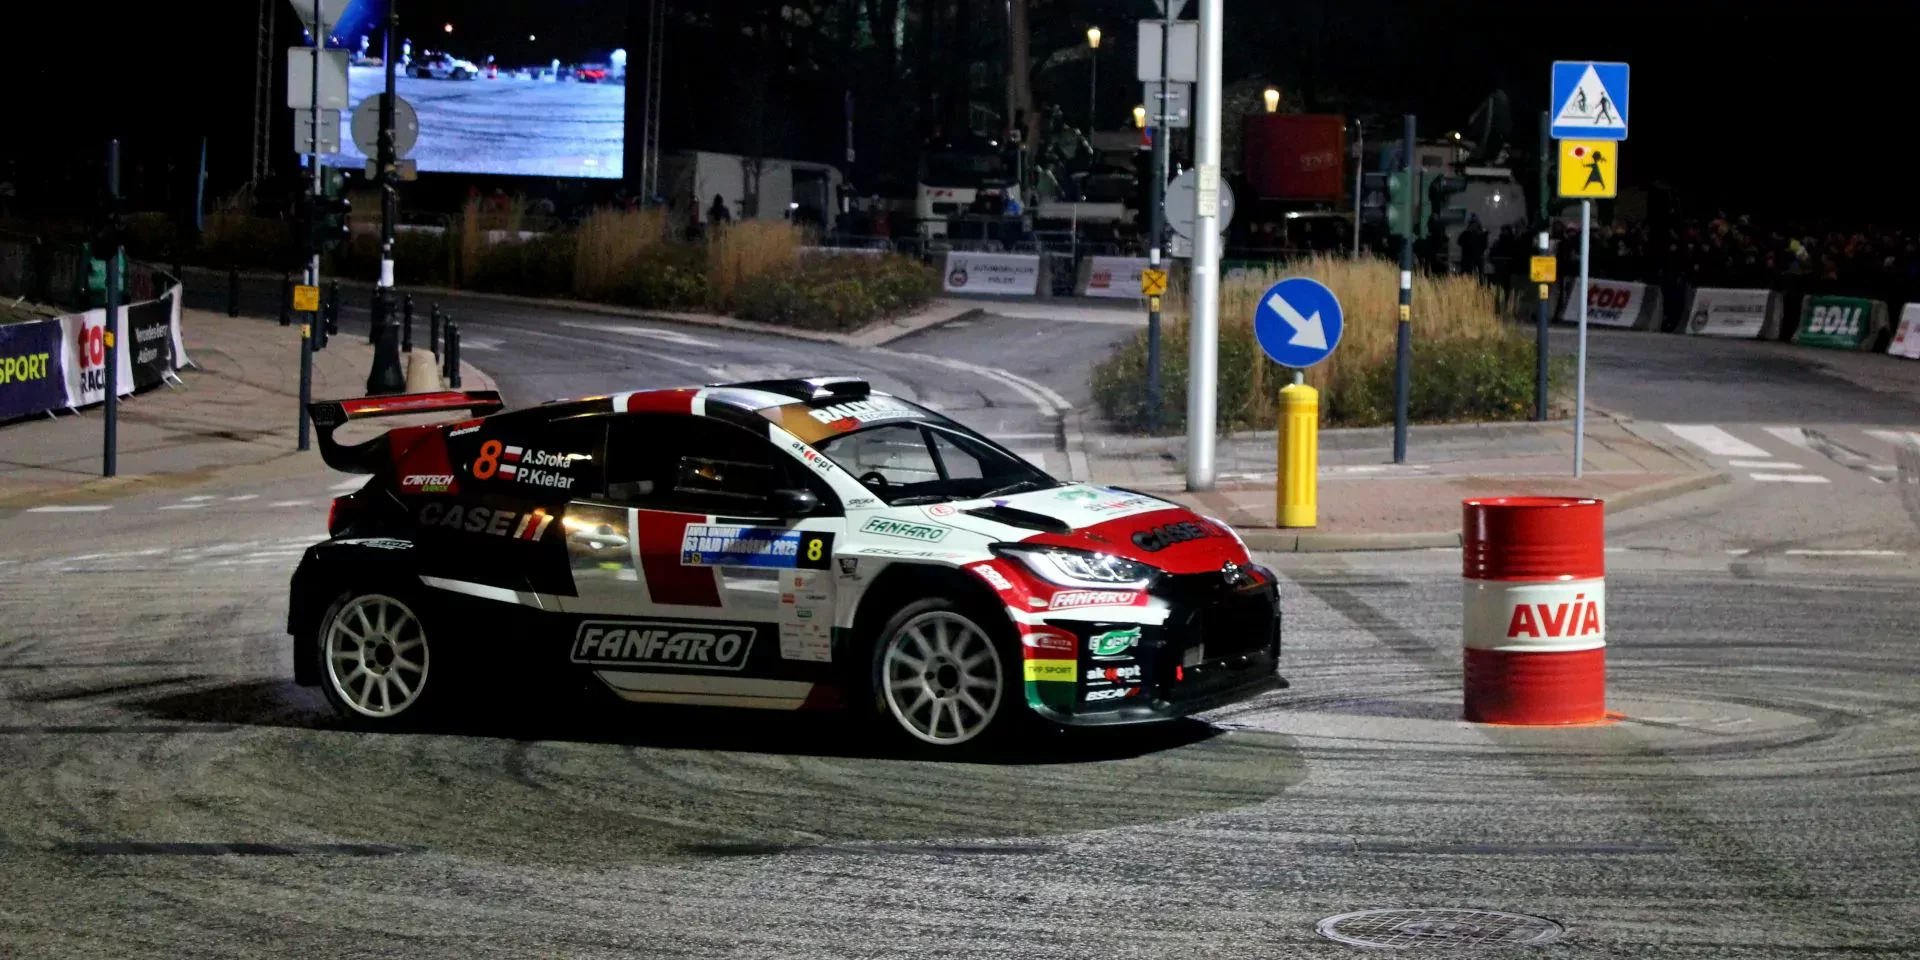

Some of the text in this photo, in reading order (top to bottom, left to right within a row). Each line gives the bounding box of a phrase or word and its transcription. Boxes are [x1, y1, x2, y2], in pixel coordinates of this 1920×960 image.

[1808, 305, 1862, 335] BOLL
[78, 322, 105, 369] to
[473, 440, 502, 480] 8
[522, 449, 571, 468] A.Sroka
[402, 475, 454, 486] CARTECH
[517, 468, 575, 489] P.Kielar
[419, 502, 516, 537] CASE
[865, 519, 944, 540] FANFARO
[807, 538, 823, 561] 8
[1131, 521, 1208, 552] CASE
[1054, 592, 1131, 608] FANFARO
[1507, 593, 1600, 638] AVIA
[580, 628, 742, 663] FANFARO
[1045, 666, 1072, 674] SPORT
